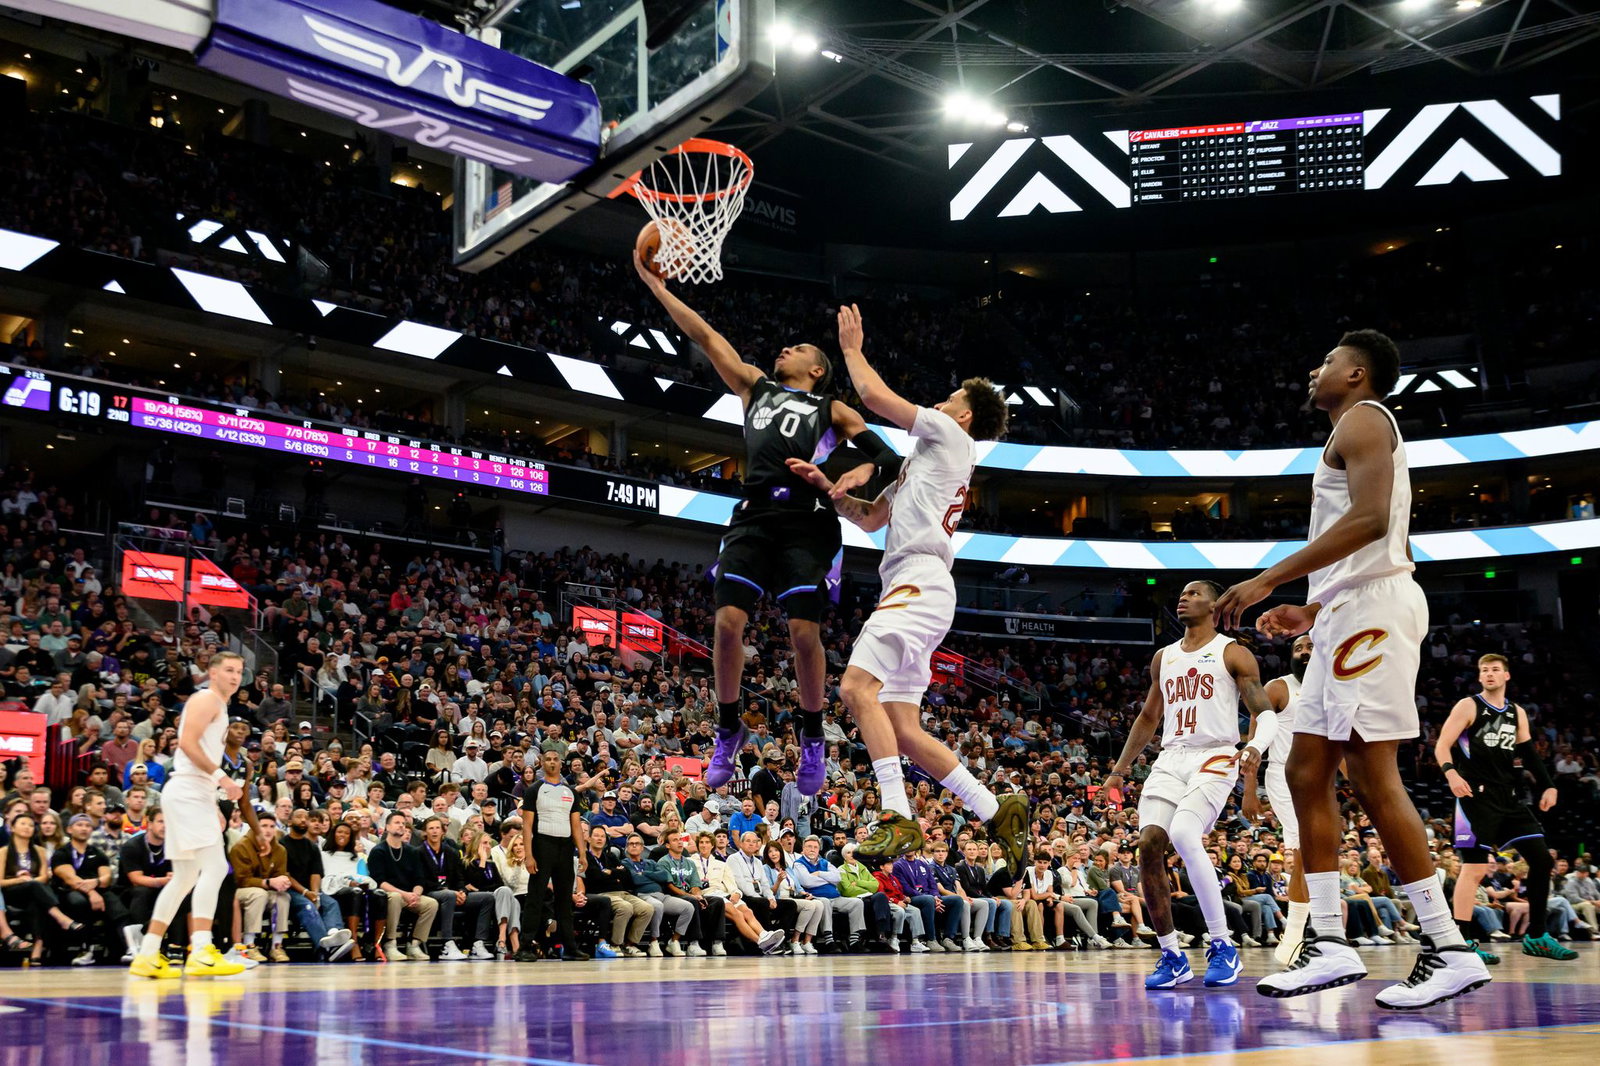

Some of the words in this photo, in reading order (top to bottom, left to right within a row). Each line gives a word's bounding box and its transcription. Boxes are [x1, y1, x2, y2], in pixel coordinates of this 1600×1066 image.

[1260, 122, 1279, 130] JAZZ
[1144, 130, 1179, 139] CAVALIERS
[59, 386, 100, 417] 6:19
[113, 395, 128, 409] 17
[107, 408, 129, 422] 2ND
[303, 421, 312, 429] FT
[780, 412, 800, 438] 0
[143, 402, 174, 415] 19/34
[218, 415, 239, 427] 3/11
[286, 427, 302, 438] 7/9
[303, 430, 328, 443] (78%)
[346, 438, 353, 447] 3
[367, 442, 376, 450] 17
[387, 445, 399, 455] 20
[410, 450, 419, 458] 12
[432, 453, 438, 462] 2
[453, 457, 459, 466] 3
[473, 461, 479, 469] 3
[493, 464, 502, 473] 13
[510, 467, 524, 477] 126
[529, 470, 543, 480] 106
[409, 440, 421, 449] AST
[431, 444, 441, 452] STL
[143, 415, 173, 429] 15/36
[216, 428, 238, 441] 4/12
[284, 440, 302, 451] 5/6
[303, 443, 329, 456] (83%)
[346, 450, 353, 460] 5
[367, 454, 375, 463] 11
[388, 458, 398, 467] 16
[409, 461, 419, 471] 12
[432, 465, 438, 474] 2
[473, 472, 479, 481] 3
[494, 476, 500, 485] 7
[510, 479, 524, 488] 106
[529, 482, 543, 492] 126
[451, 448, 462, 456] BLK
[607, 481, 633, 504] 7:49
[637, 486, 656, 508] PM
[1022, 621, 1055, 632] HEALTH
[1333, 628, 1389, 681] C
[1165, 673, 1214, 705] CAVS
[1175, 706, 1197, 736] 14
[1500, 733, 1516, 751] 22
